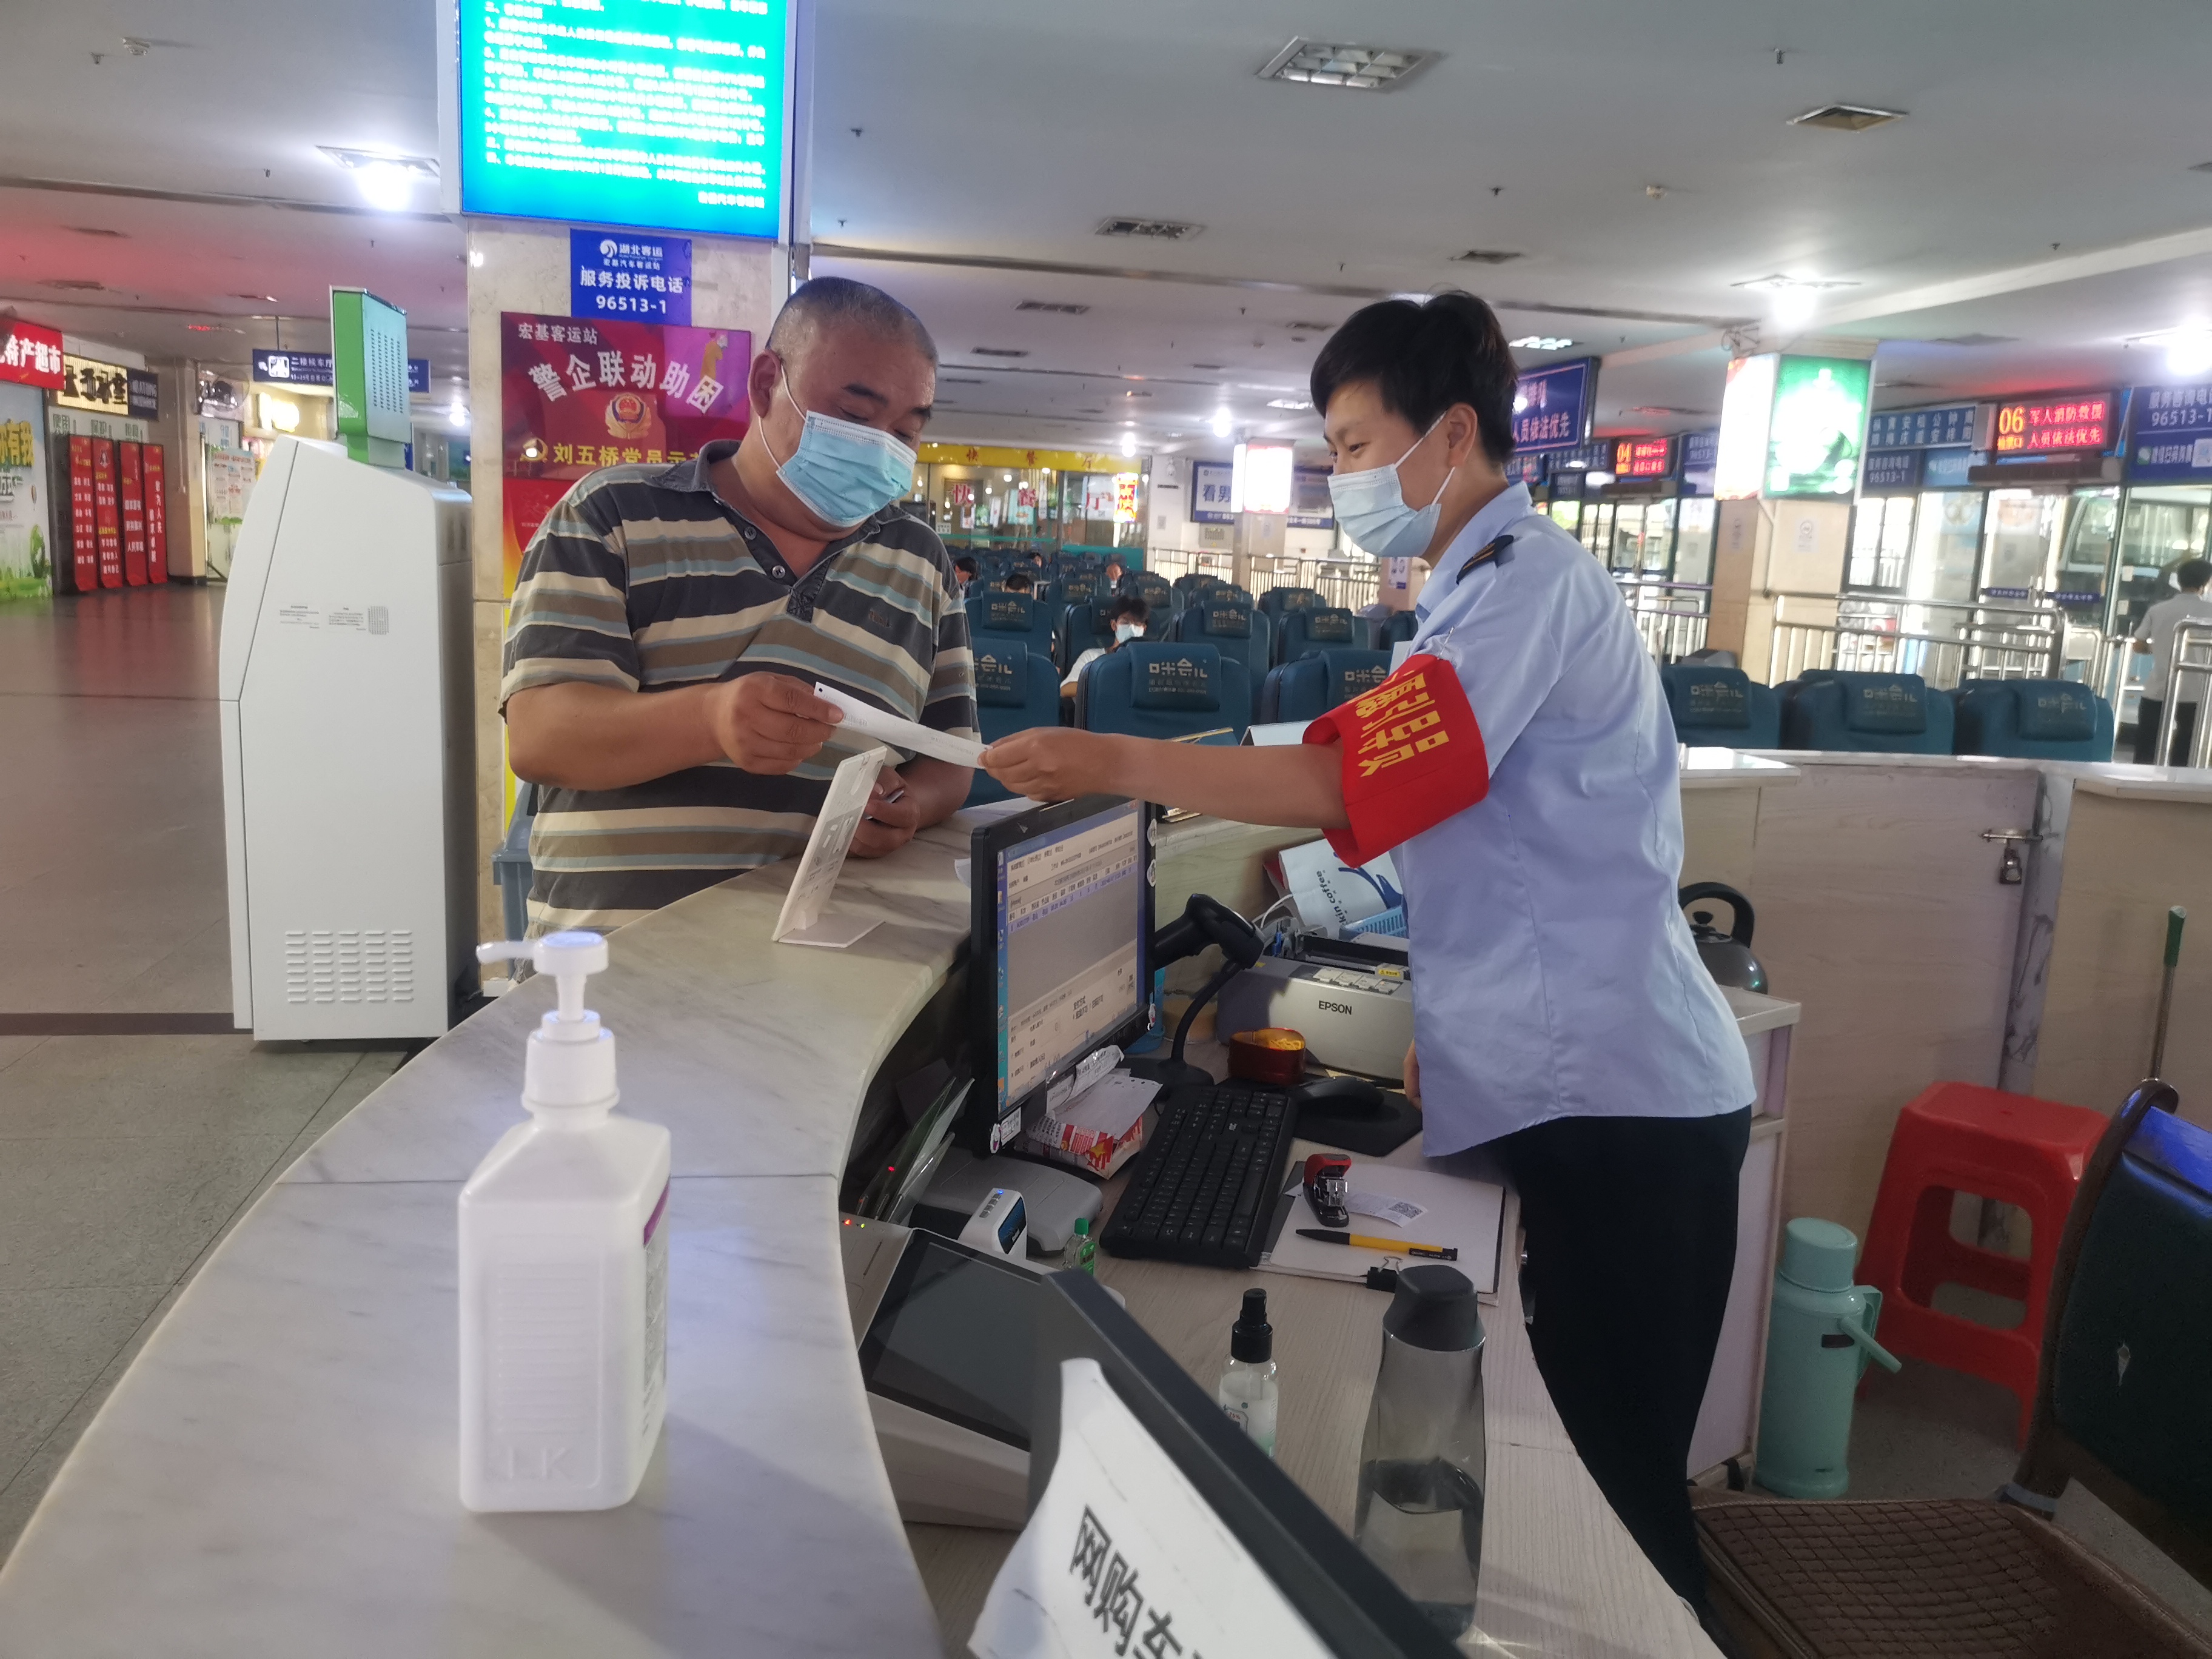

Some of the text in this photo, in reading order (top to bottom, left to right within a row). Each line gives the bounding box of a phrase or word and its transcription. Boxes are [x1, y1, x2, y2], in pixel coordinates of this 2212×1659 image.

[580, 268, 684, 293] 服务投诉电话
[596, 295, 666, 313] 96513-1
[518, 323, 598, 346] 宏基客运站
[0, 334, 61, 374] 特产超市
[528, 350, 724, 414] 警企联动助困
[1999, 406, 2026, 434] 06
[2152, 407, 2212, 427] 96513-1
[2028, 426, 2103, 449] 人员依法优先
[554, 443, 700, 466] 刘五桥党员示
[1617, 443, 1632, 463] 04
[974, 654, 1013, 674] 会儿
[1344, 665, 1389, 684] 咪会
[1346, 670, 1450, 777] 愿引导员
[1316, 871, 1335, 903] coffee
[1318, 1000, 1352, 1016] EPSON
[1070, 1503, 1204, 1659] 网购车
